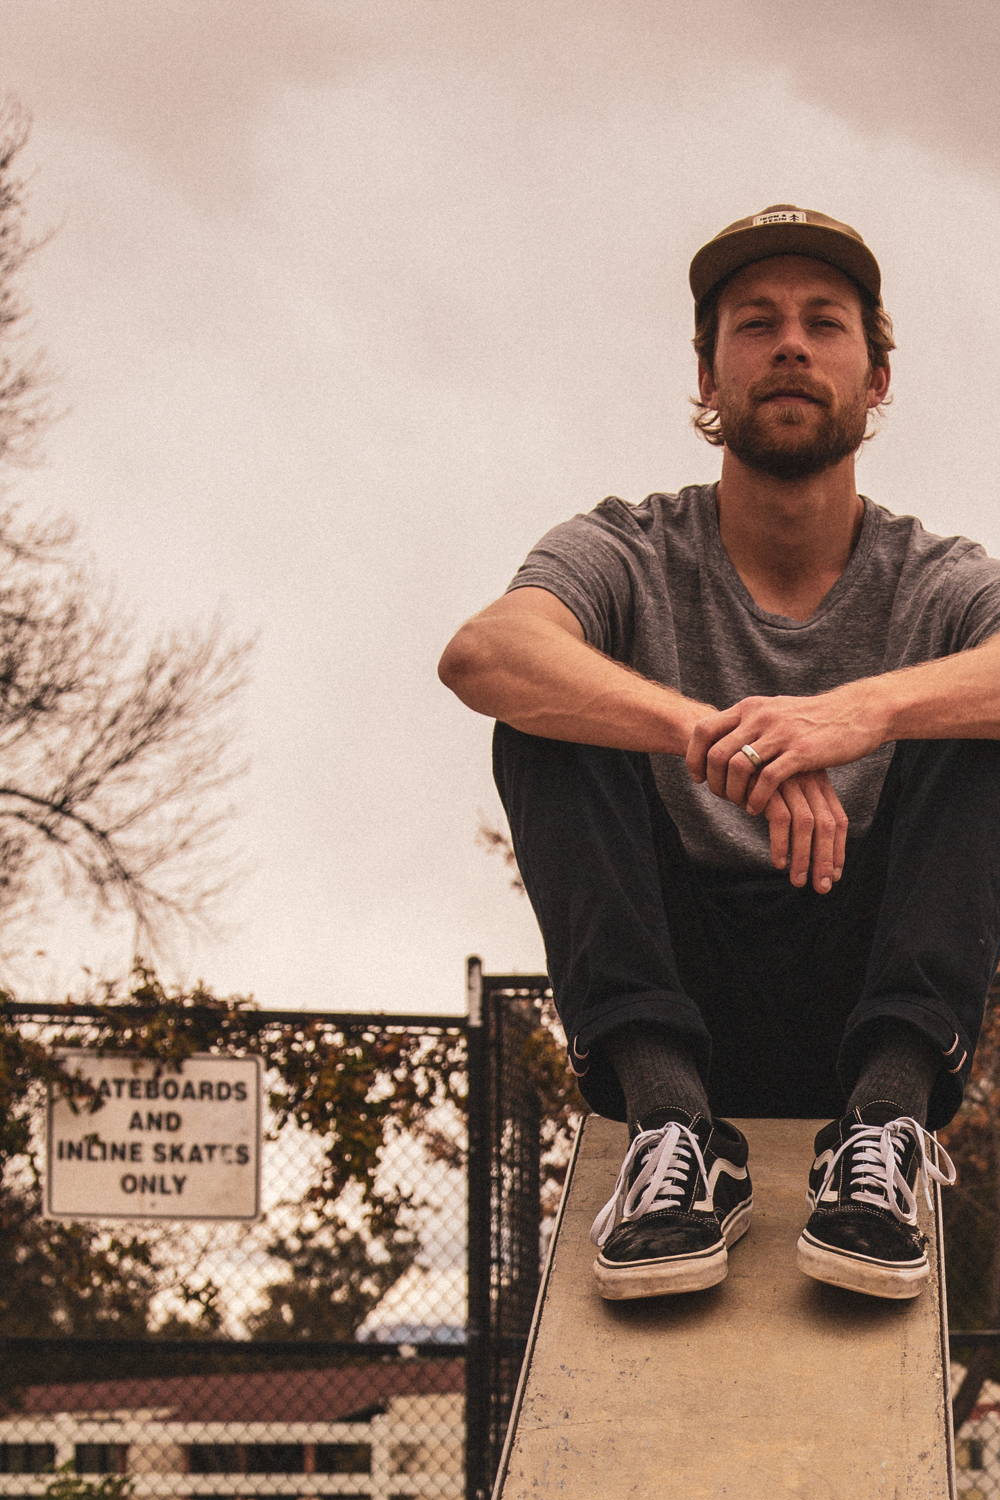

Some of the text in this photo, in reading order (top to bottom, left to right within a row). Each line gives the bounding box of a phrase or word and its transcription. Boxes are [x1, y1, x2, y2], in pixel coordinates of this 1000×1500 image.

[66, 1077, 248, 1102] ATEBOARDS
[128, 1110, 183, 1131] AND
[56, 1139, 143, 1162] INLINE
[120, 1174, 187, 1195] ONLY
